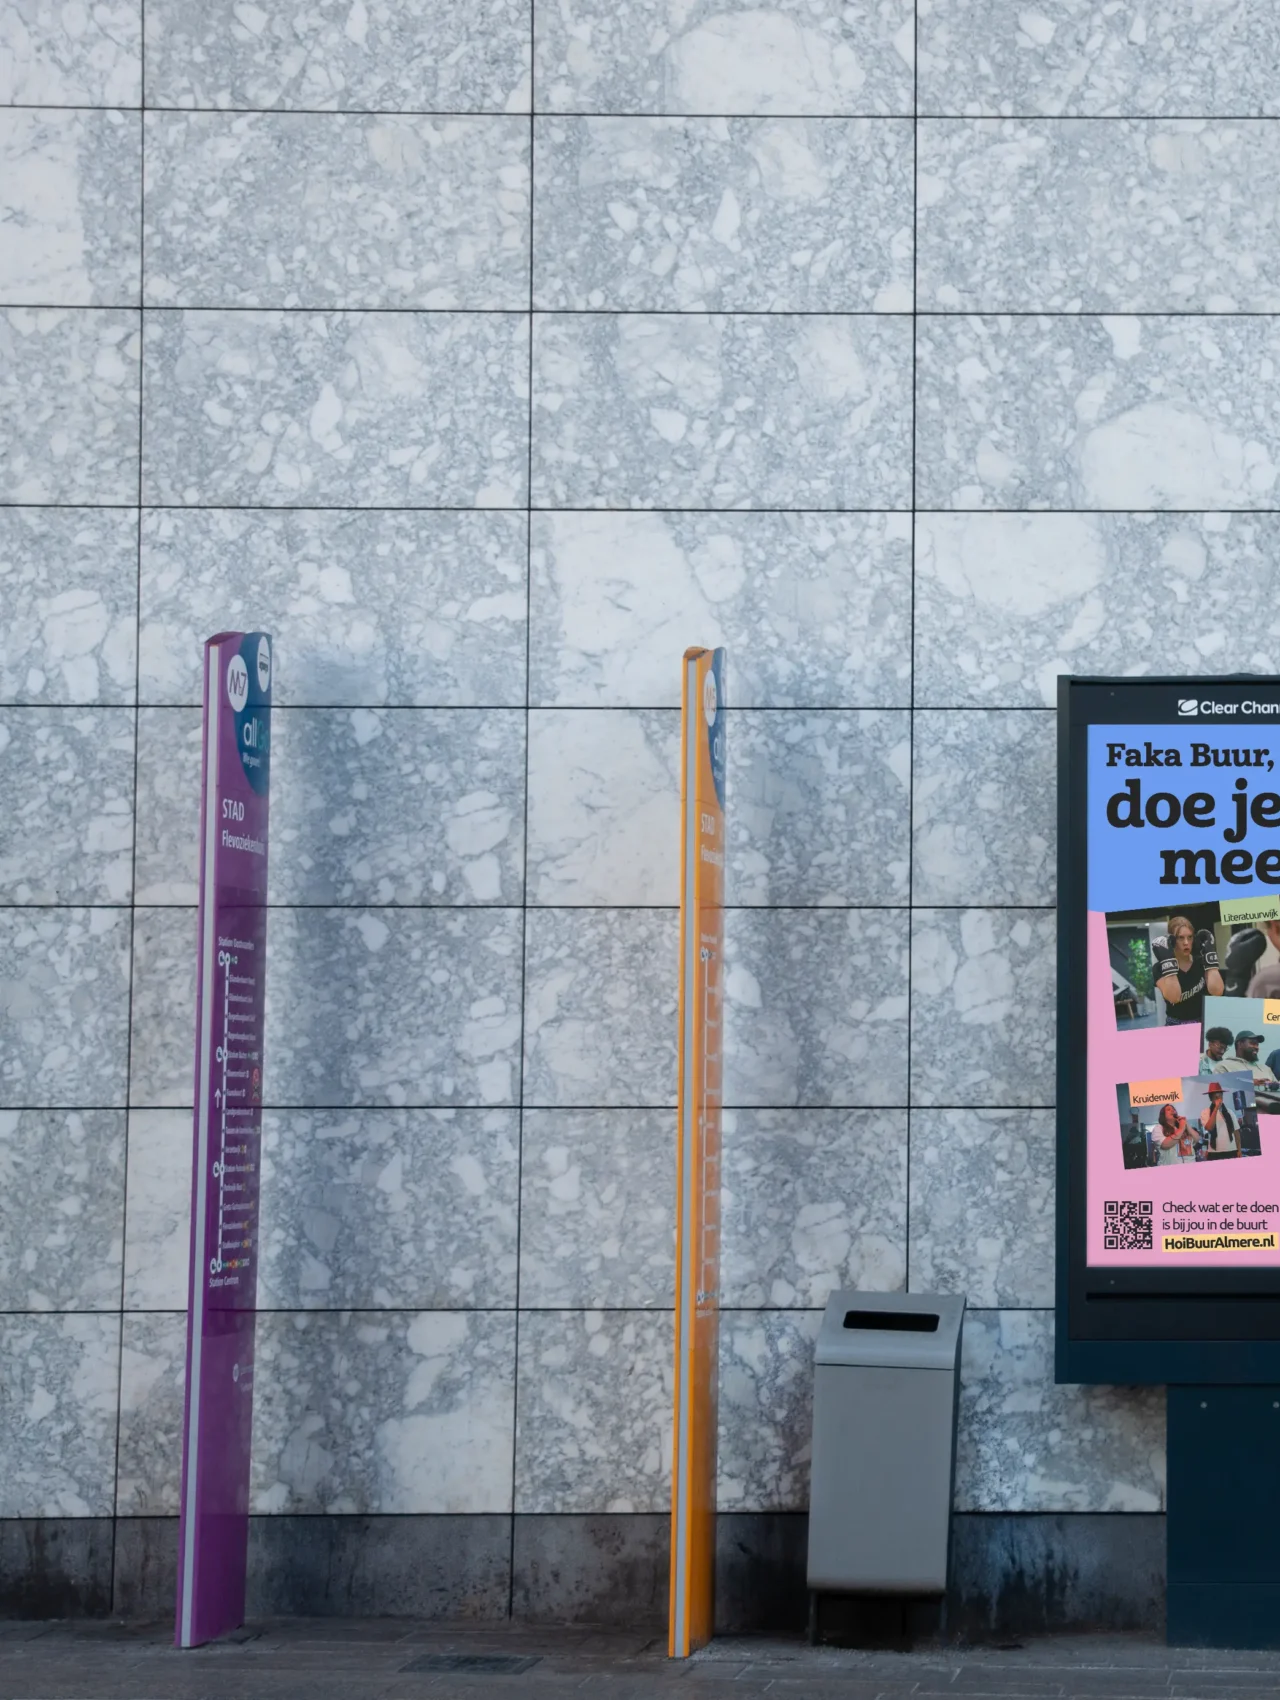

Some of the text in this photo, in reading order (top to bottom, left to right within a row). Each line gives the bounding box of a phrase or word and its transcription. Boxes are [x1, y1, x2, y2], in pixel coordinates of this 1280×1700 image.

[229, 669, 247, 697] M7
[1200, 701, 1239, 715] Clear
[1106, 742, 1275, 772] Faka Buur,
[222, 798, 245, 821] STAD
[1106, 778, 1216, 828] doe
[1223, 909, 1279, 922] Literatuurwijk
[1132, 1091, 1180, 1103] Kruidenwijk
[1162, 1201, 1279, 1213] Check wat er te doen
[1162, 1218, 1268, 1232] is bij jou in de buurt
[1164, 1235, 1275, 1250] HoiBuurAlmere.nl
